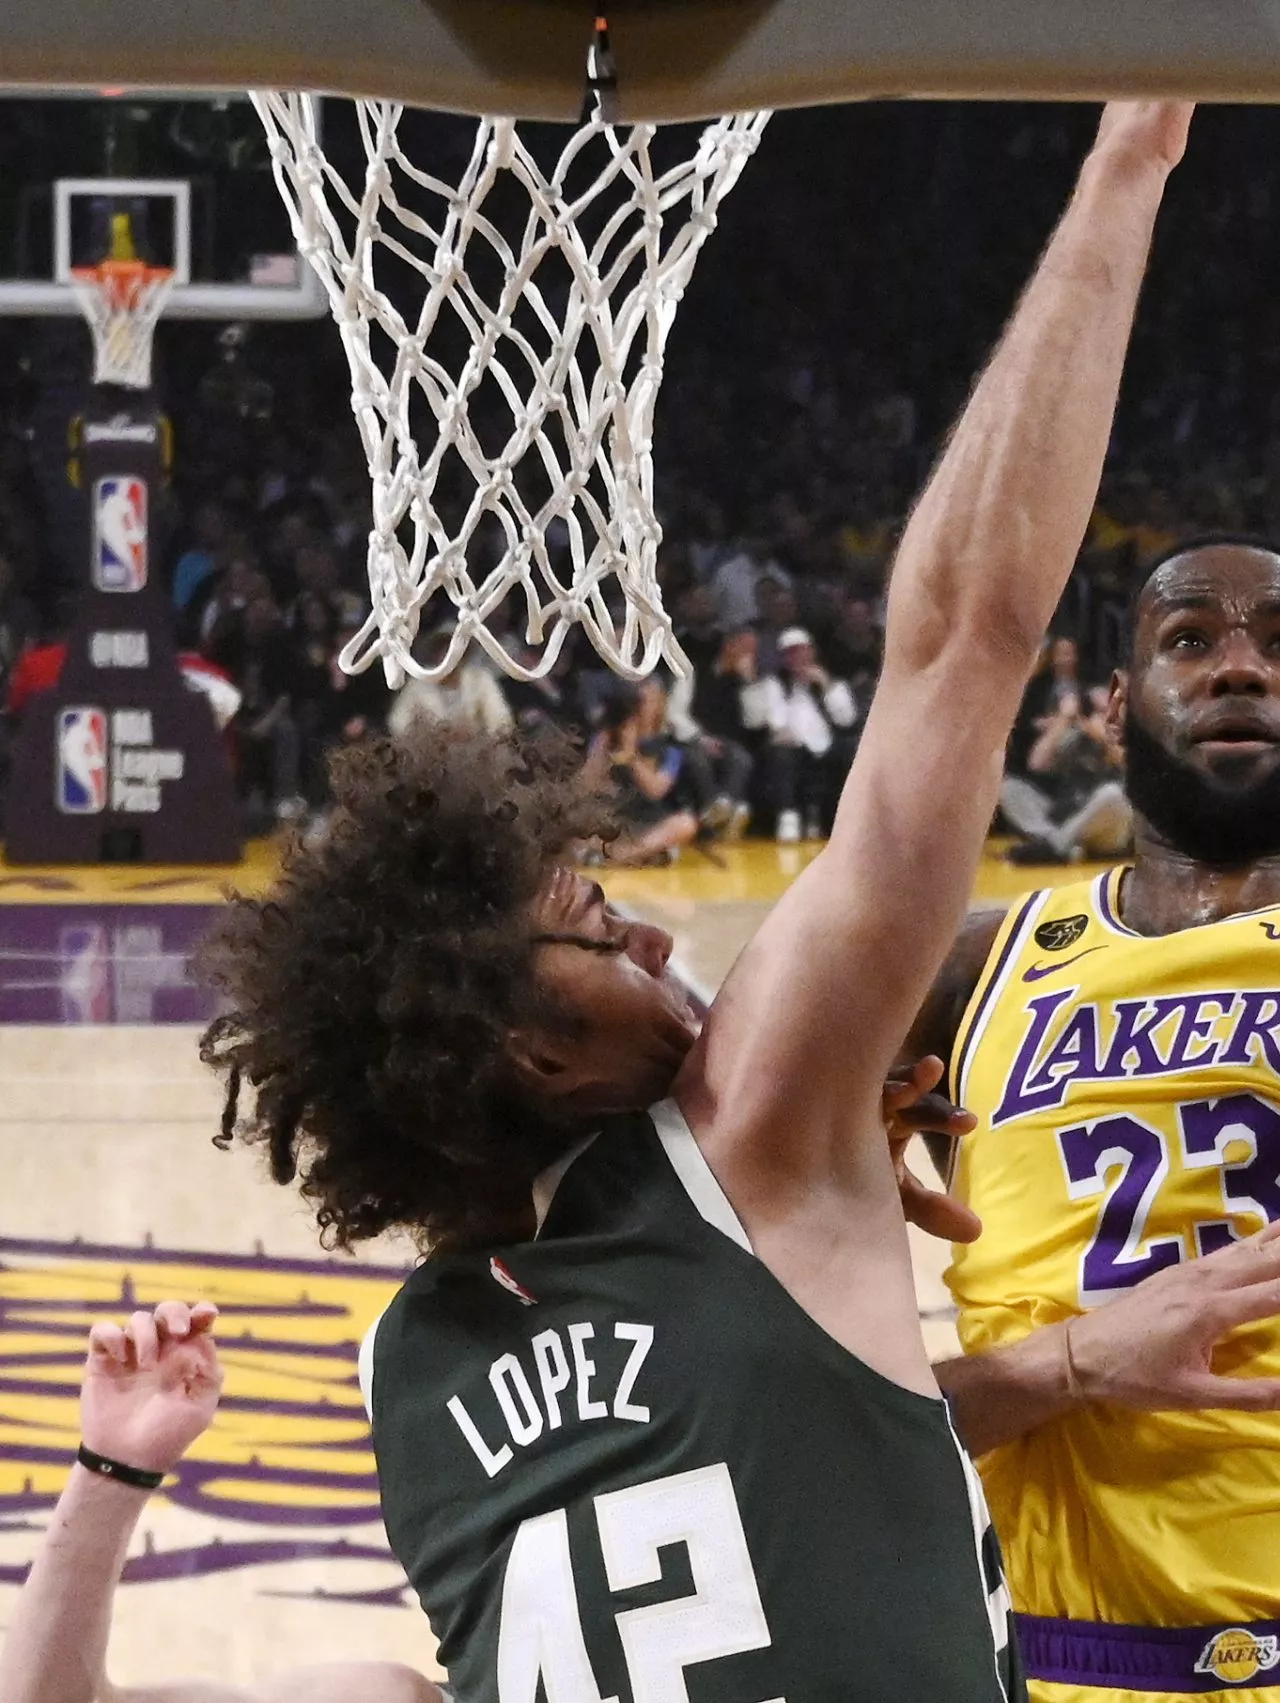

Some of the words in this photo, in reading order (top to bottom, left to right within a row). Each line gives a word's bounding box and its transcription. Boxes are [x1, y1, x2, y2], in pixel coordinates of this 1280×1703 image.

[446, 1321, 655, 1479] LOPEZ
[496, 1461, 788, 1703] 42
[1199, 1642, 1276, 1670] LAKERS
